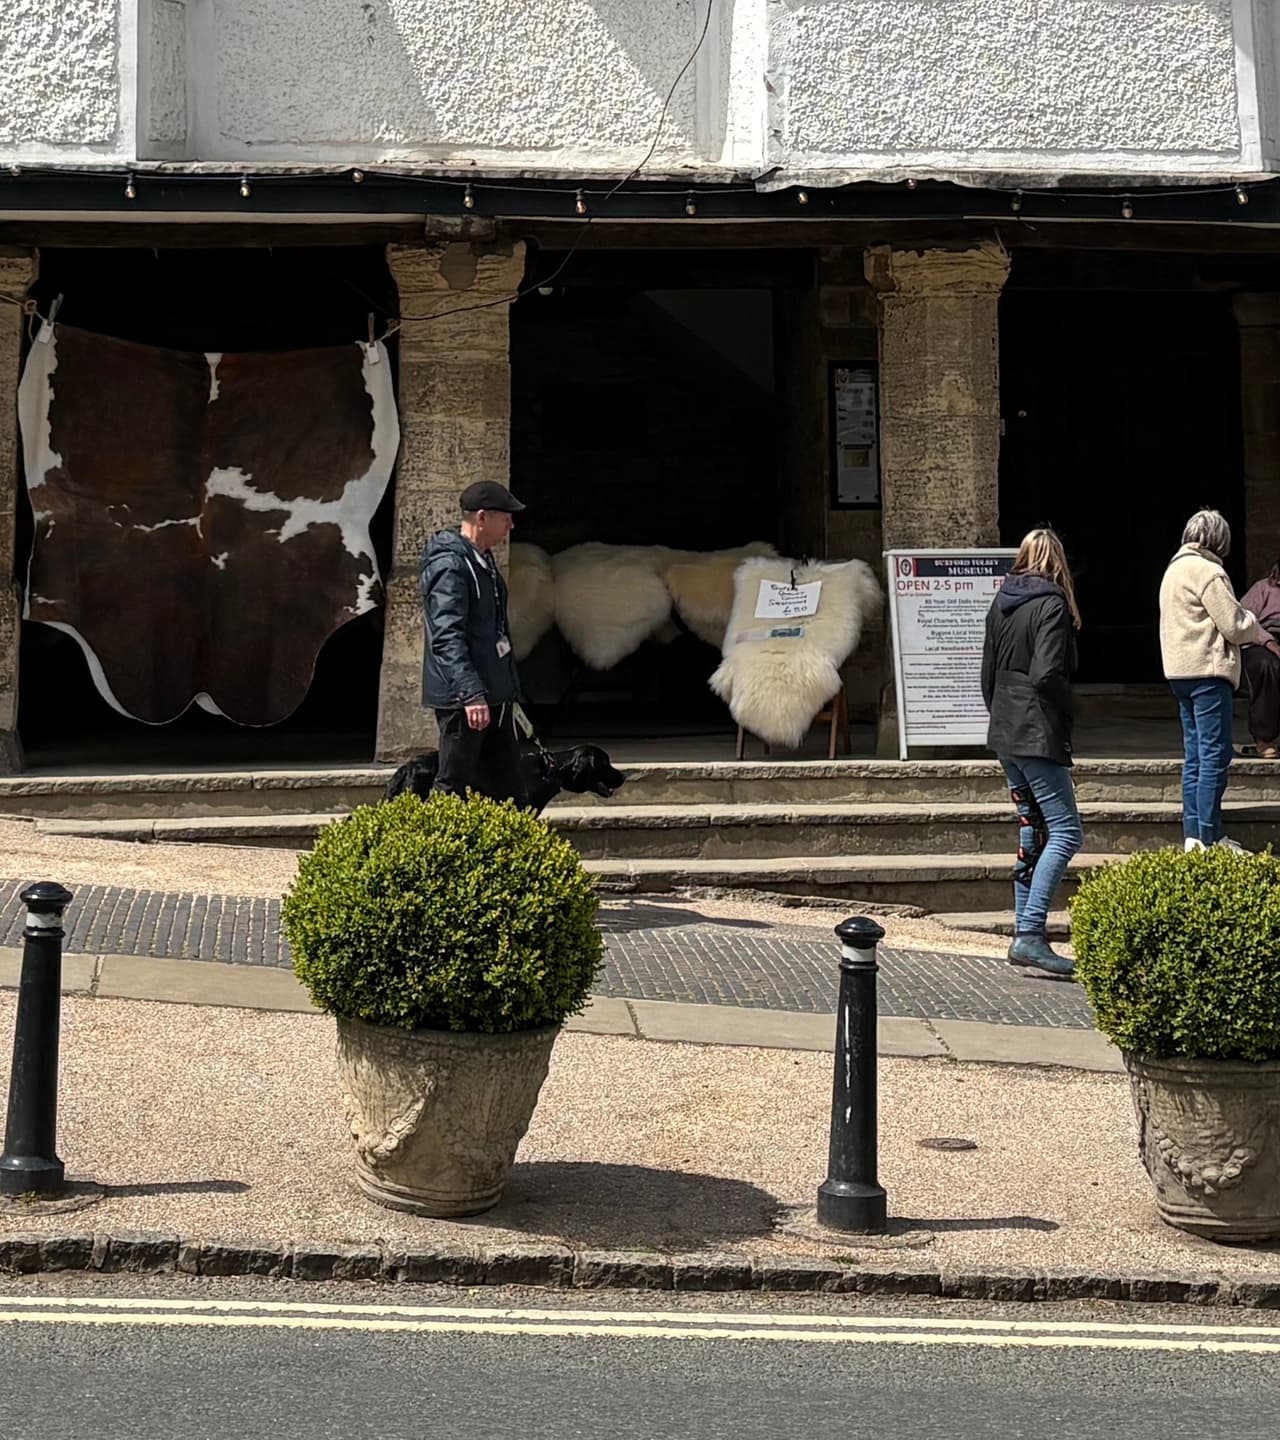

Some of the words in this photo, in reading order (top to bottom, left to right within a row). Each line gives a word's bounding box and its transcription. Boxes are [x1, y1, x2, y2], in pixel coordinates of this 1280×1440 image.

[948, 566, 993, 575] MUSEUM
[896, 580, 930, 591] OPEN
[933, 580, 951, 591] 2-5
[954, 582, 973, 592] pm
